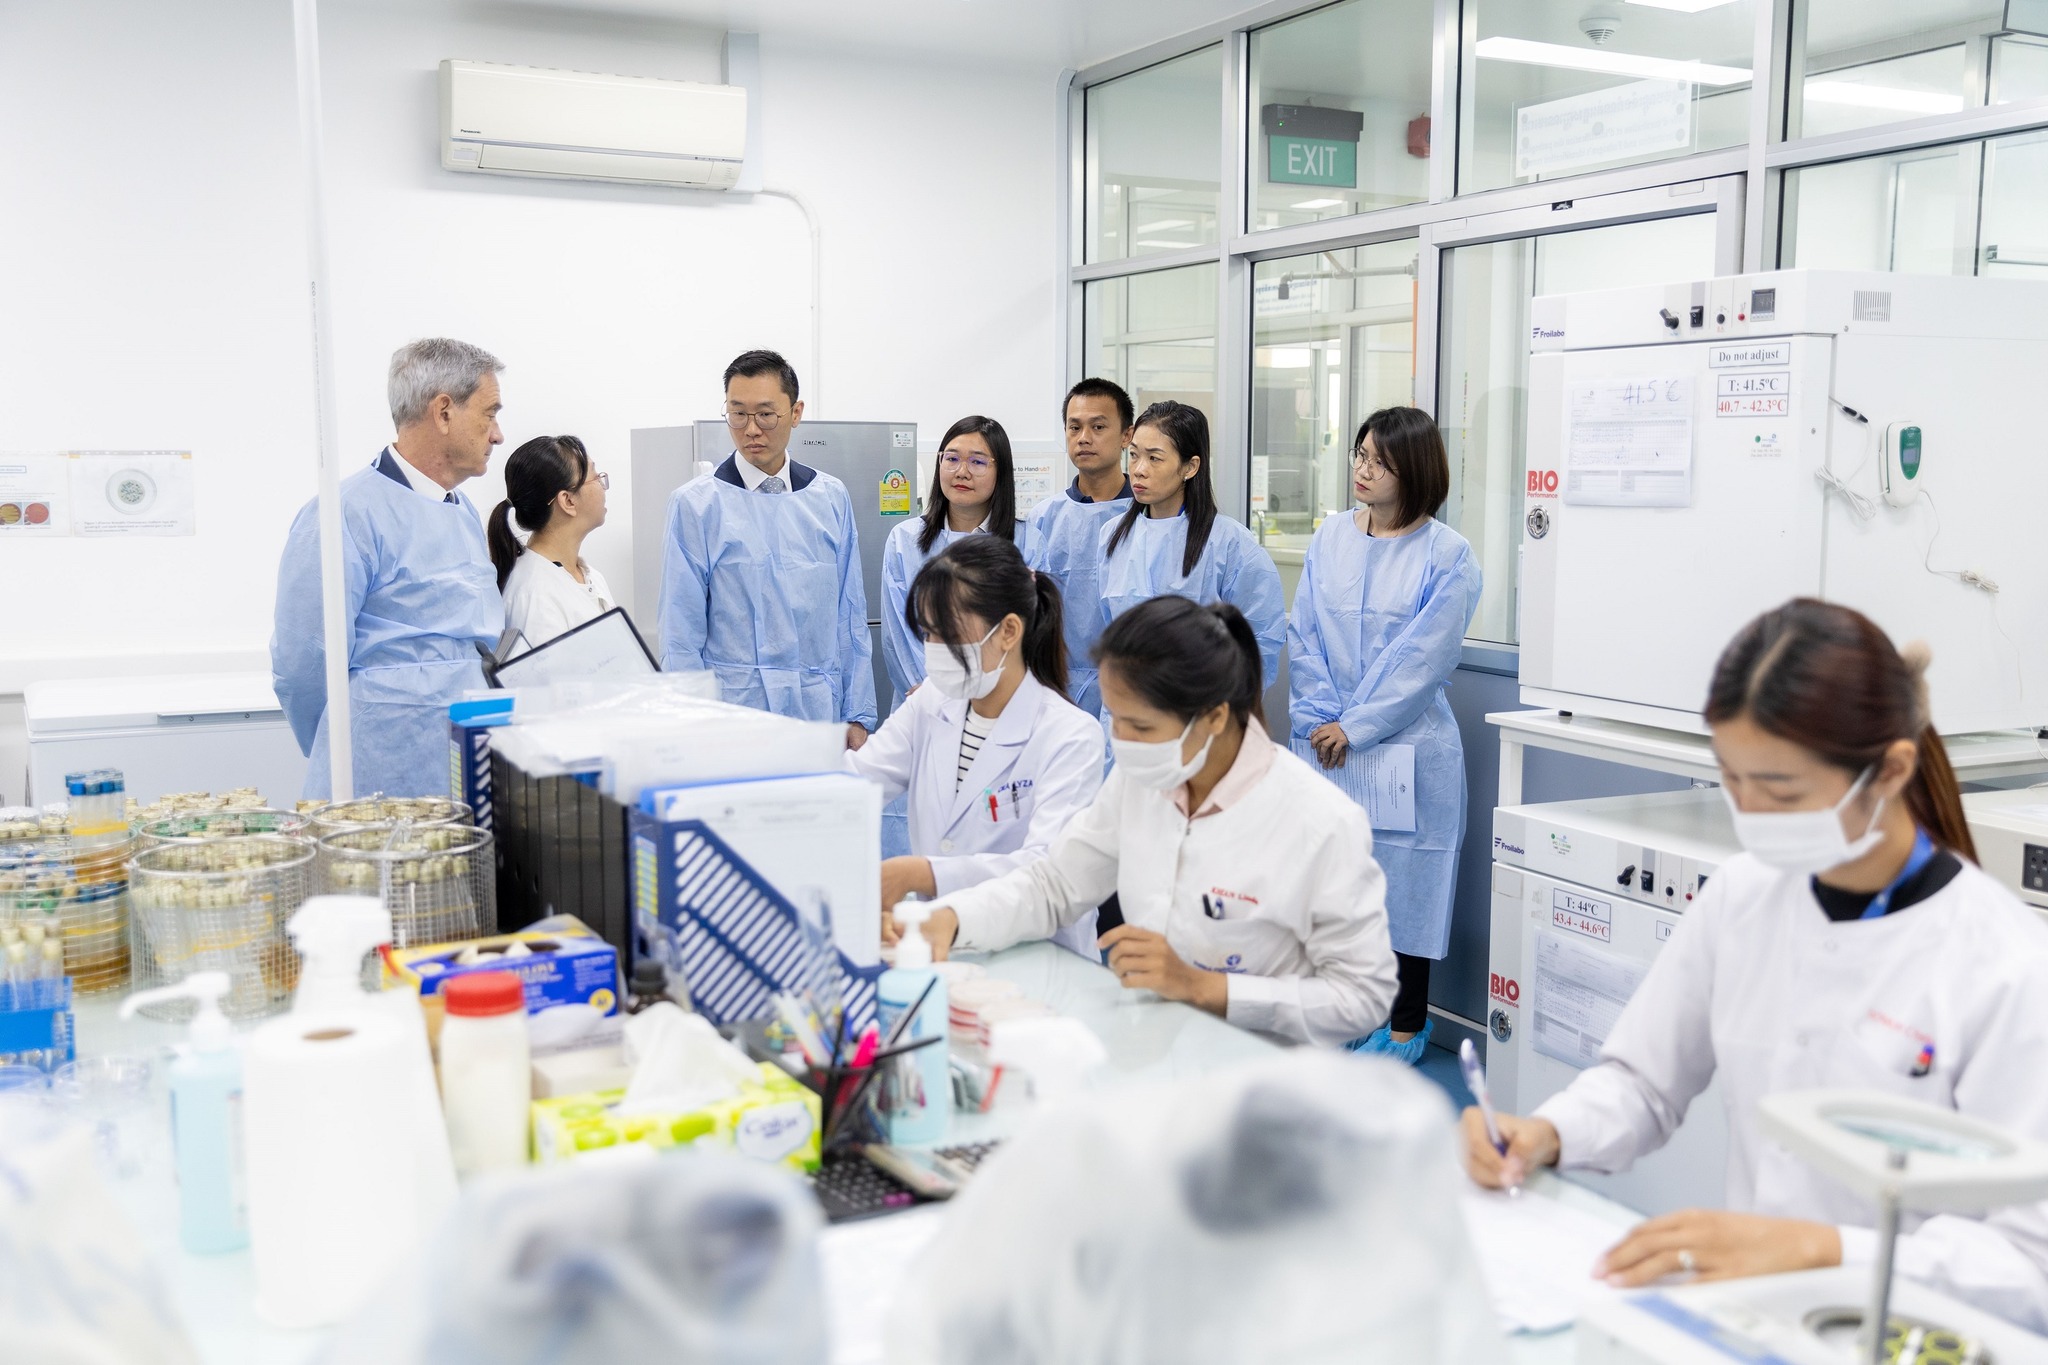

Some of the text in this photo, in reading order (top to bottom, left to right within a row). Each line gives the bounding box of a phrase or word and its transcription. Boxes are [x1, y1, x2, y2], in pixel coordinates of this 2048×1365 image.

[1287, 143, 1338, 177] EXIT
[1540, 330, 1565, 338] Froilabo
[1719, 349, 1779, 362] Do not adjust
[1623, 380, 1657, 405] 41.5
[1728, 379, 1740, 392] T:
[1718, 400, 1740, 413] 40.7
[1527, 470, 1559, 492] BIO
[1527, 491, 1559, 499] Performance
[1501, 842, 1525, 855] Froilabo
[1565, 895, 1575, 909] T:
[1554, 911, 1572, 926] 43.4
[1490, 972, 1520, 1002] BIO
[1490, 992, 1520, 1009] Performance
